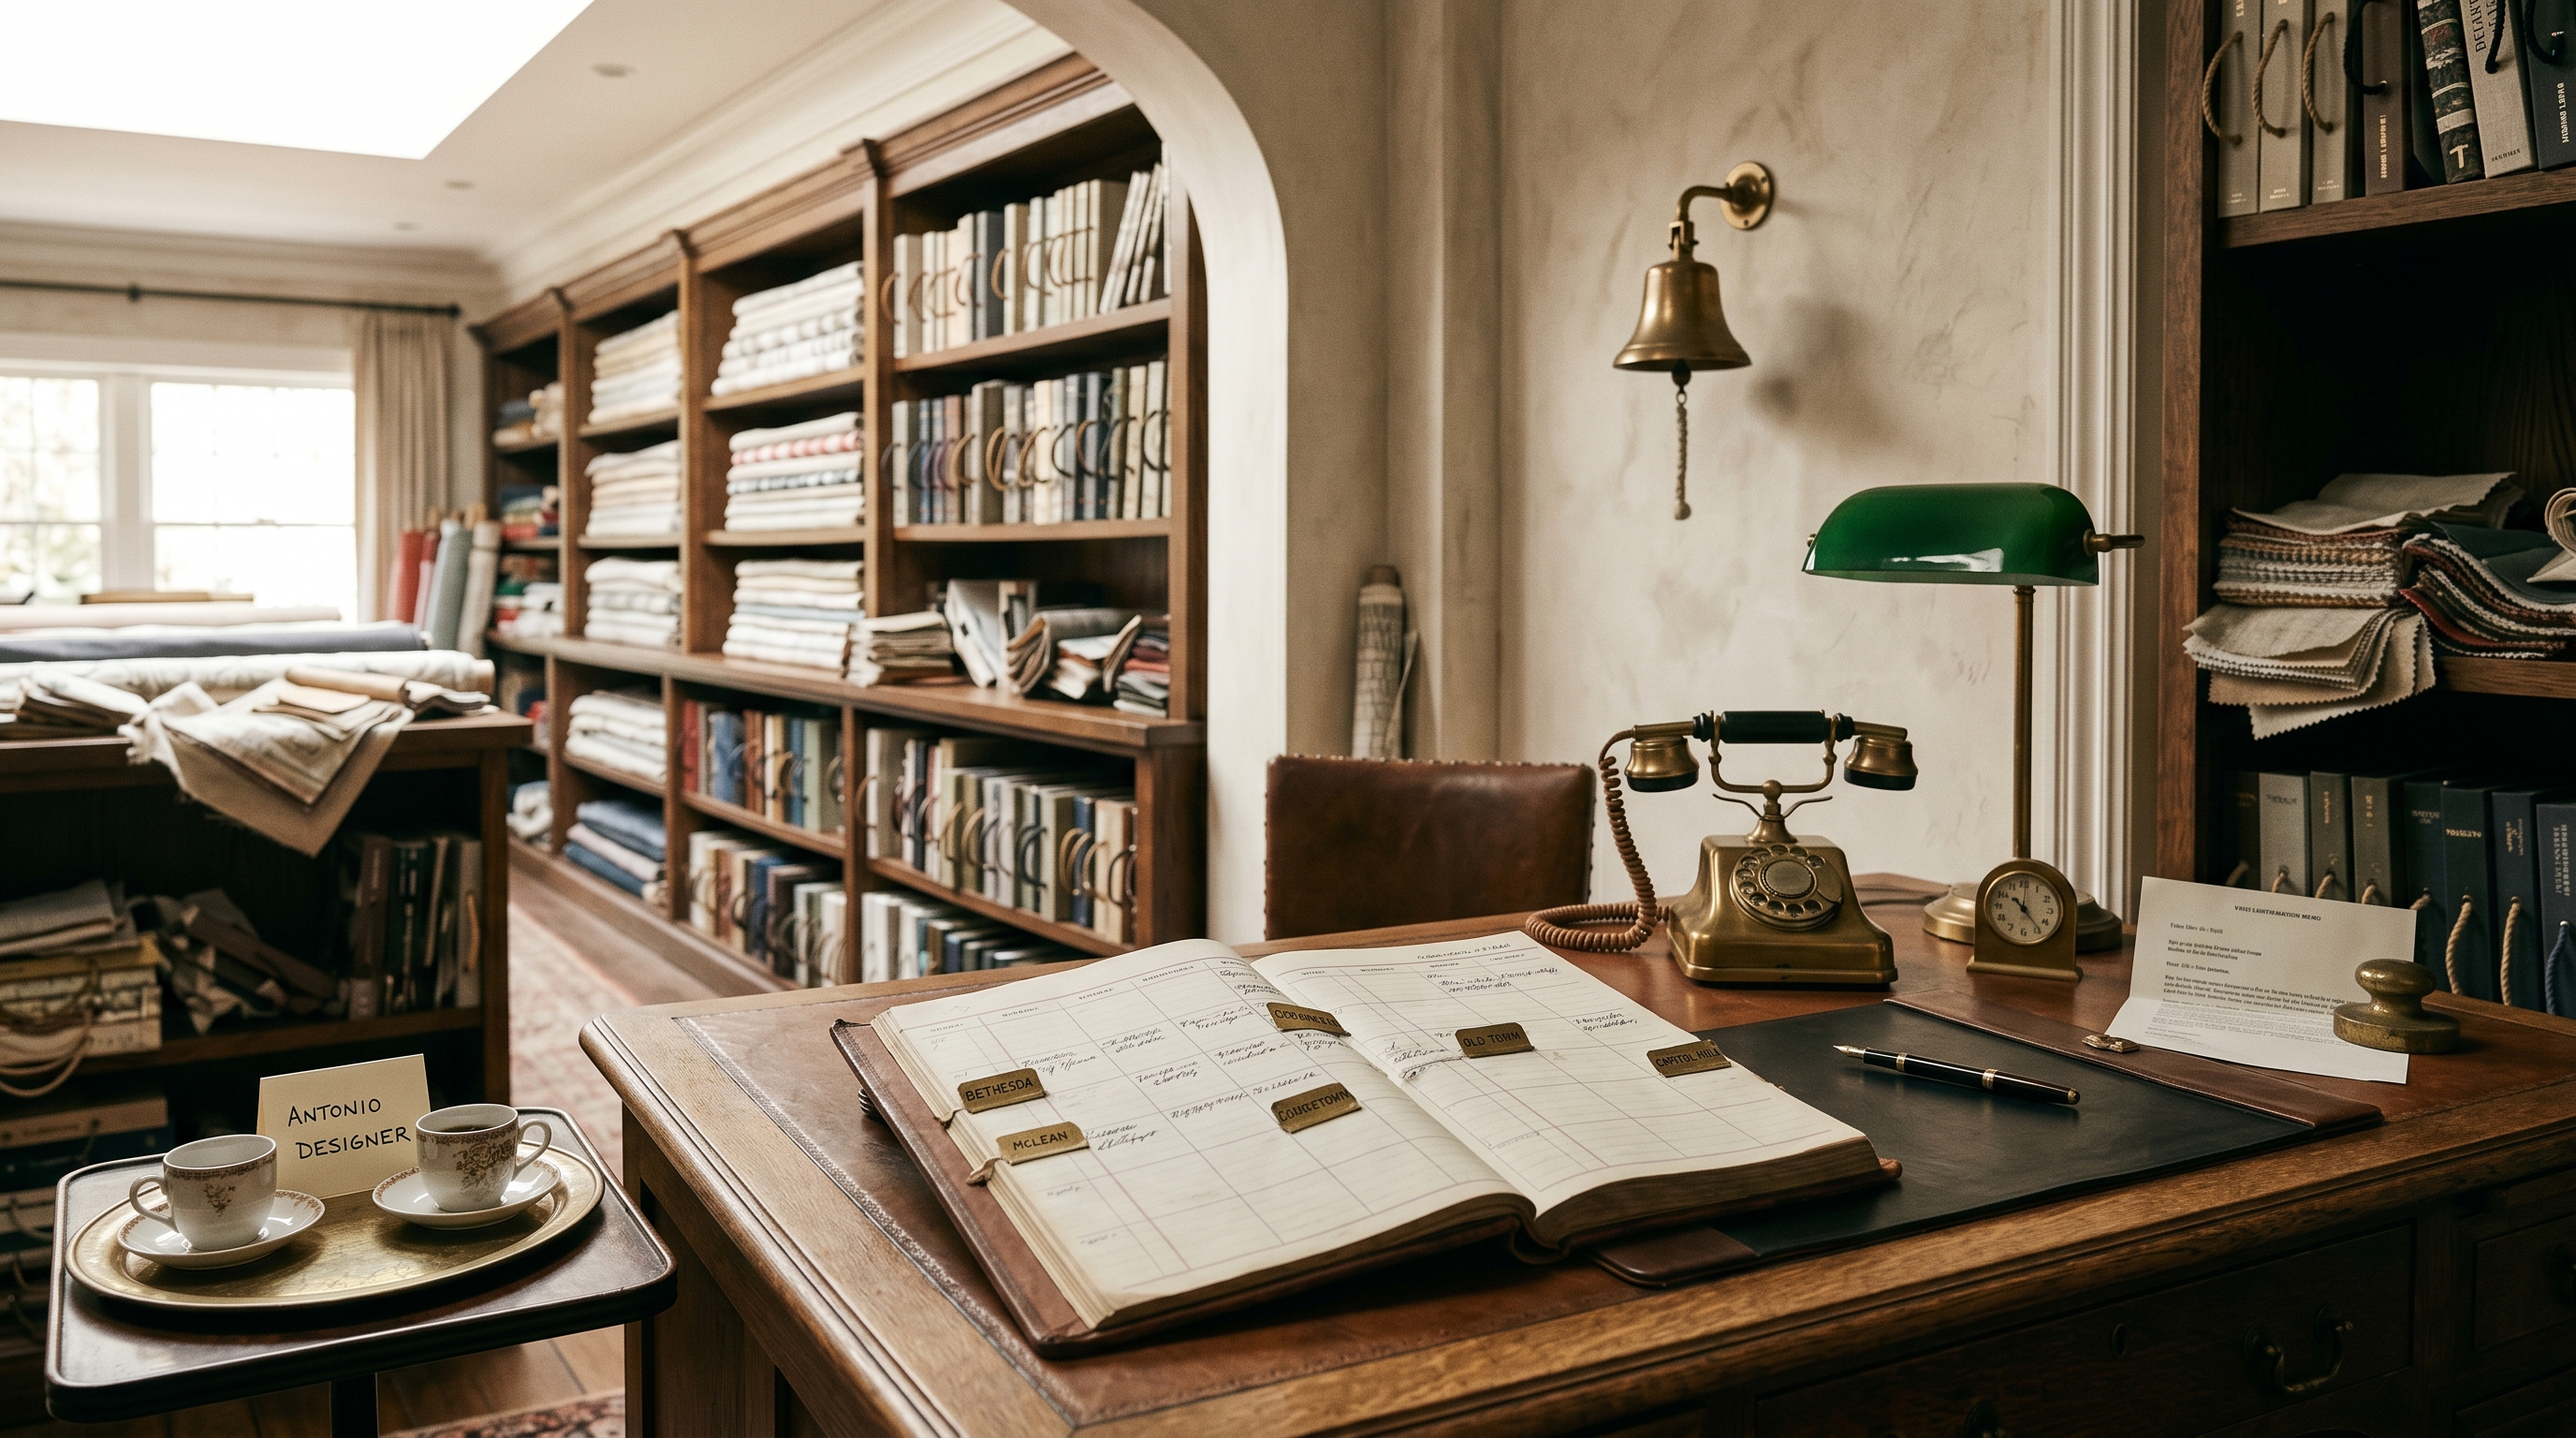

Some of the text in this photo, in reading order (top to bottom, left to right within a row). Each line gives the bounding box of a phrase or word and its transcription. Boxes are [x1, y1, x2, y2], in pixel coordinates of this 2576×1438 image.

[1462, 1037, 1486, 1048] OLD
[965, 1078, 1033, 1102] BETHESDA
[287, 1098, 381, 1127] ANTONIO
[295, 1126, 412, 1160] DESIGNER
